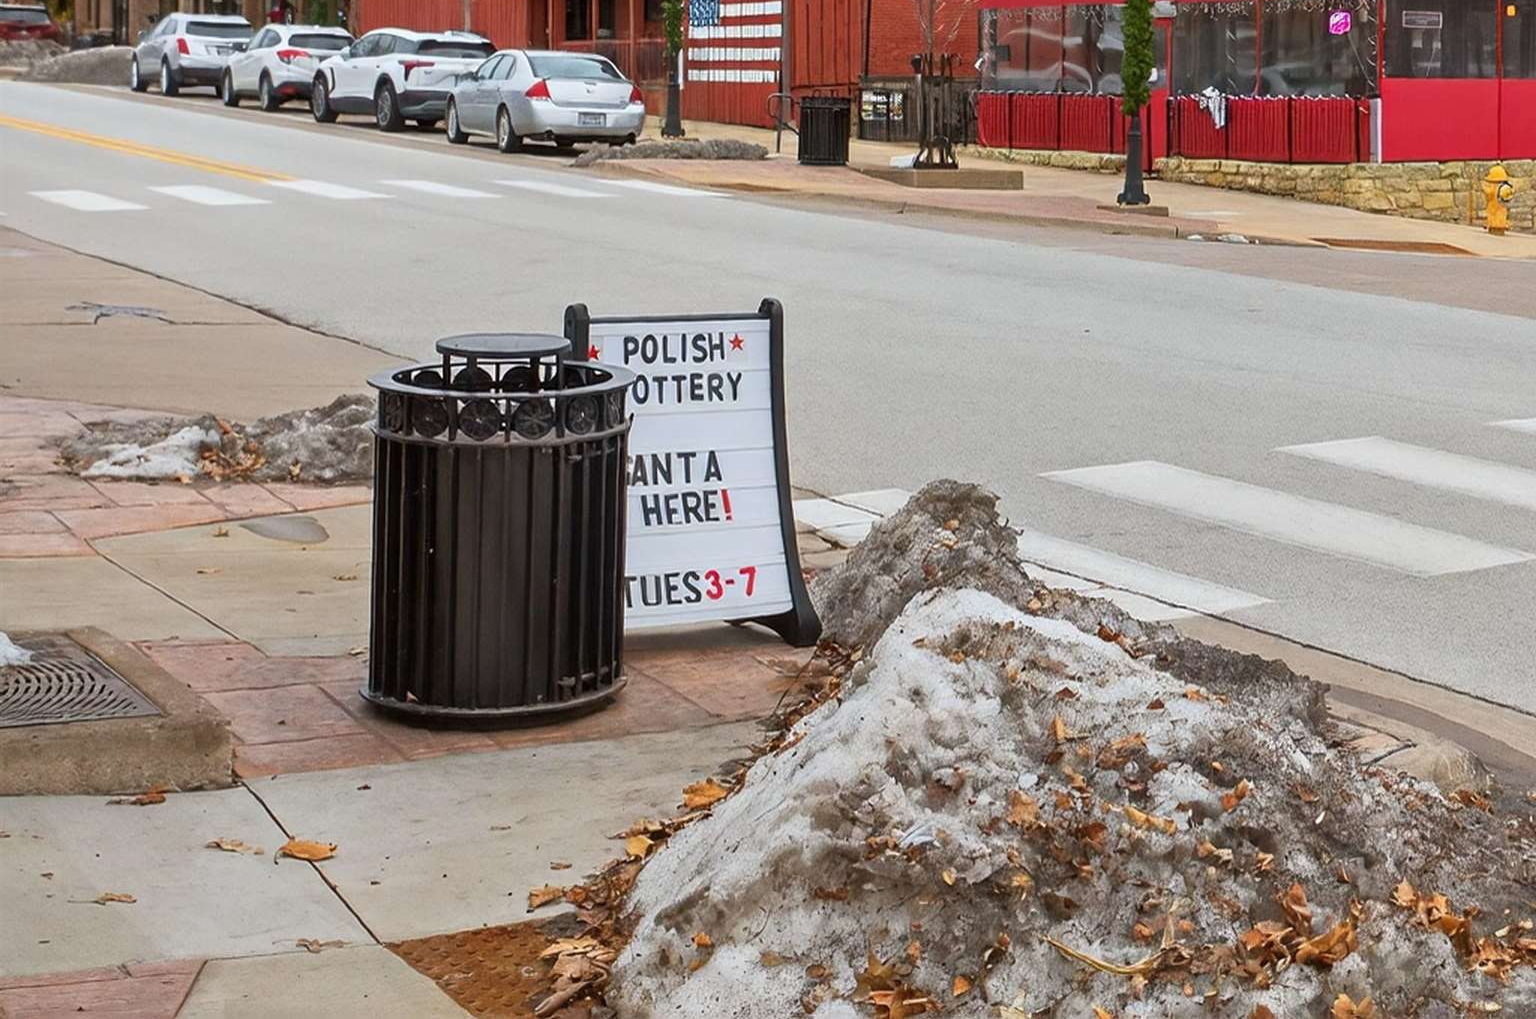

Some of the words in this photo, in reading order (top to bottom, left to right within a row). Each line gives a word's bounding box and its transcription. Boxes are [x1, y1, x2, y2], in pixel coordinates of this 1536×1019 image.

[623, 331, 725, 365] POLISH
[631, 371, 743, 405] OTTERY
[626, 449, 723, 486] ANTA
[640, 487, 733, 527] HERE!
